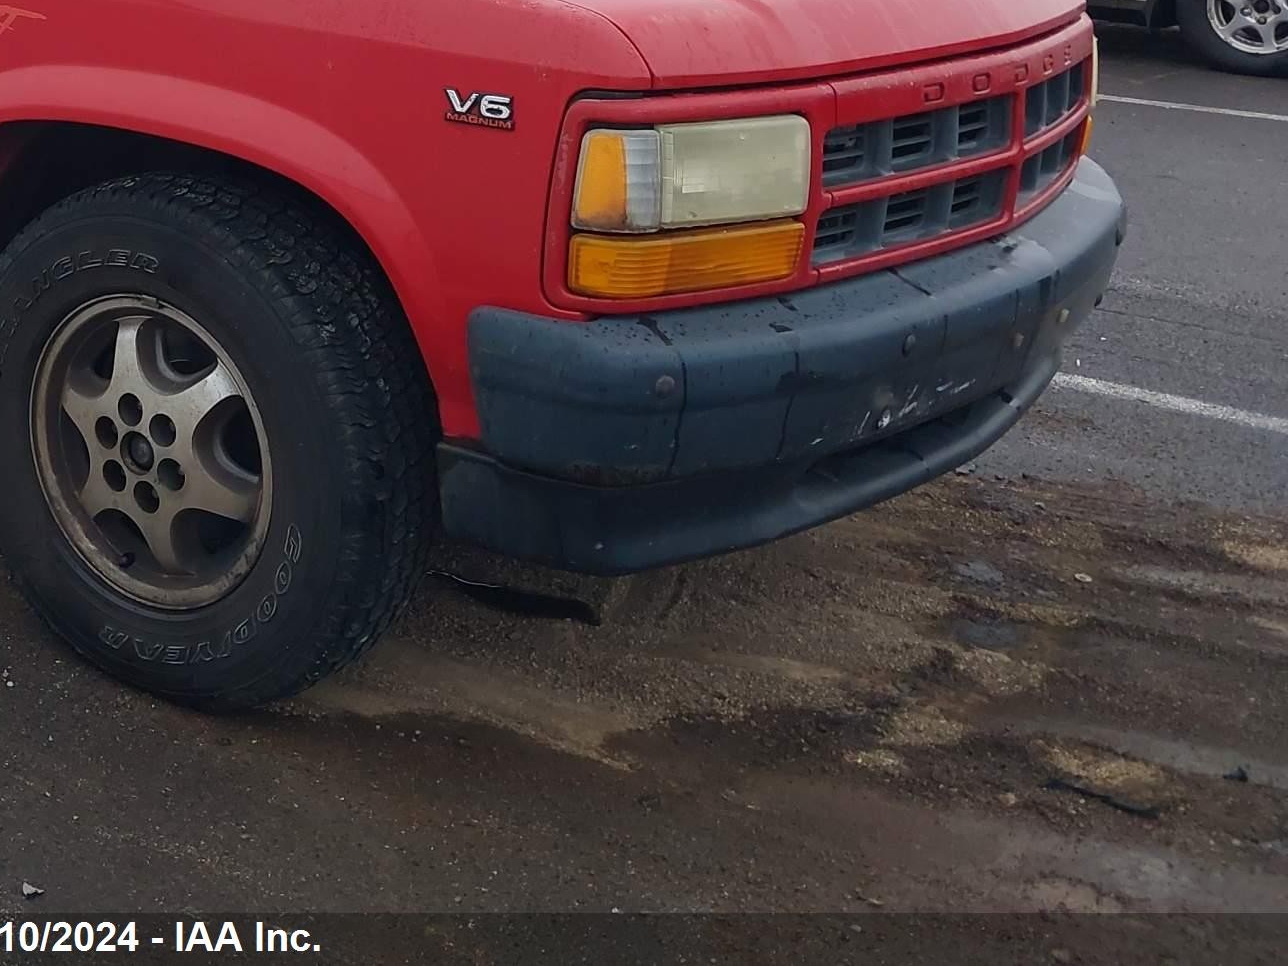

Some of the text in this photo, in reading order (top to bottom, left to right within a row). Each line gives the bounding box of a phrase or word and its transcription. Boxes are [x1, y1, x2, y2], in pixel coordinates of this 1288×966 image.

[922, 43, 1073, 104] DODGE
[445, 89, 511, 119] V6
[445, 112, 513, 130] MAGNUM
[98, 523, 303, 665] GOODYEAR
